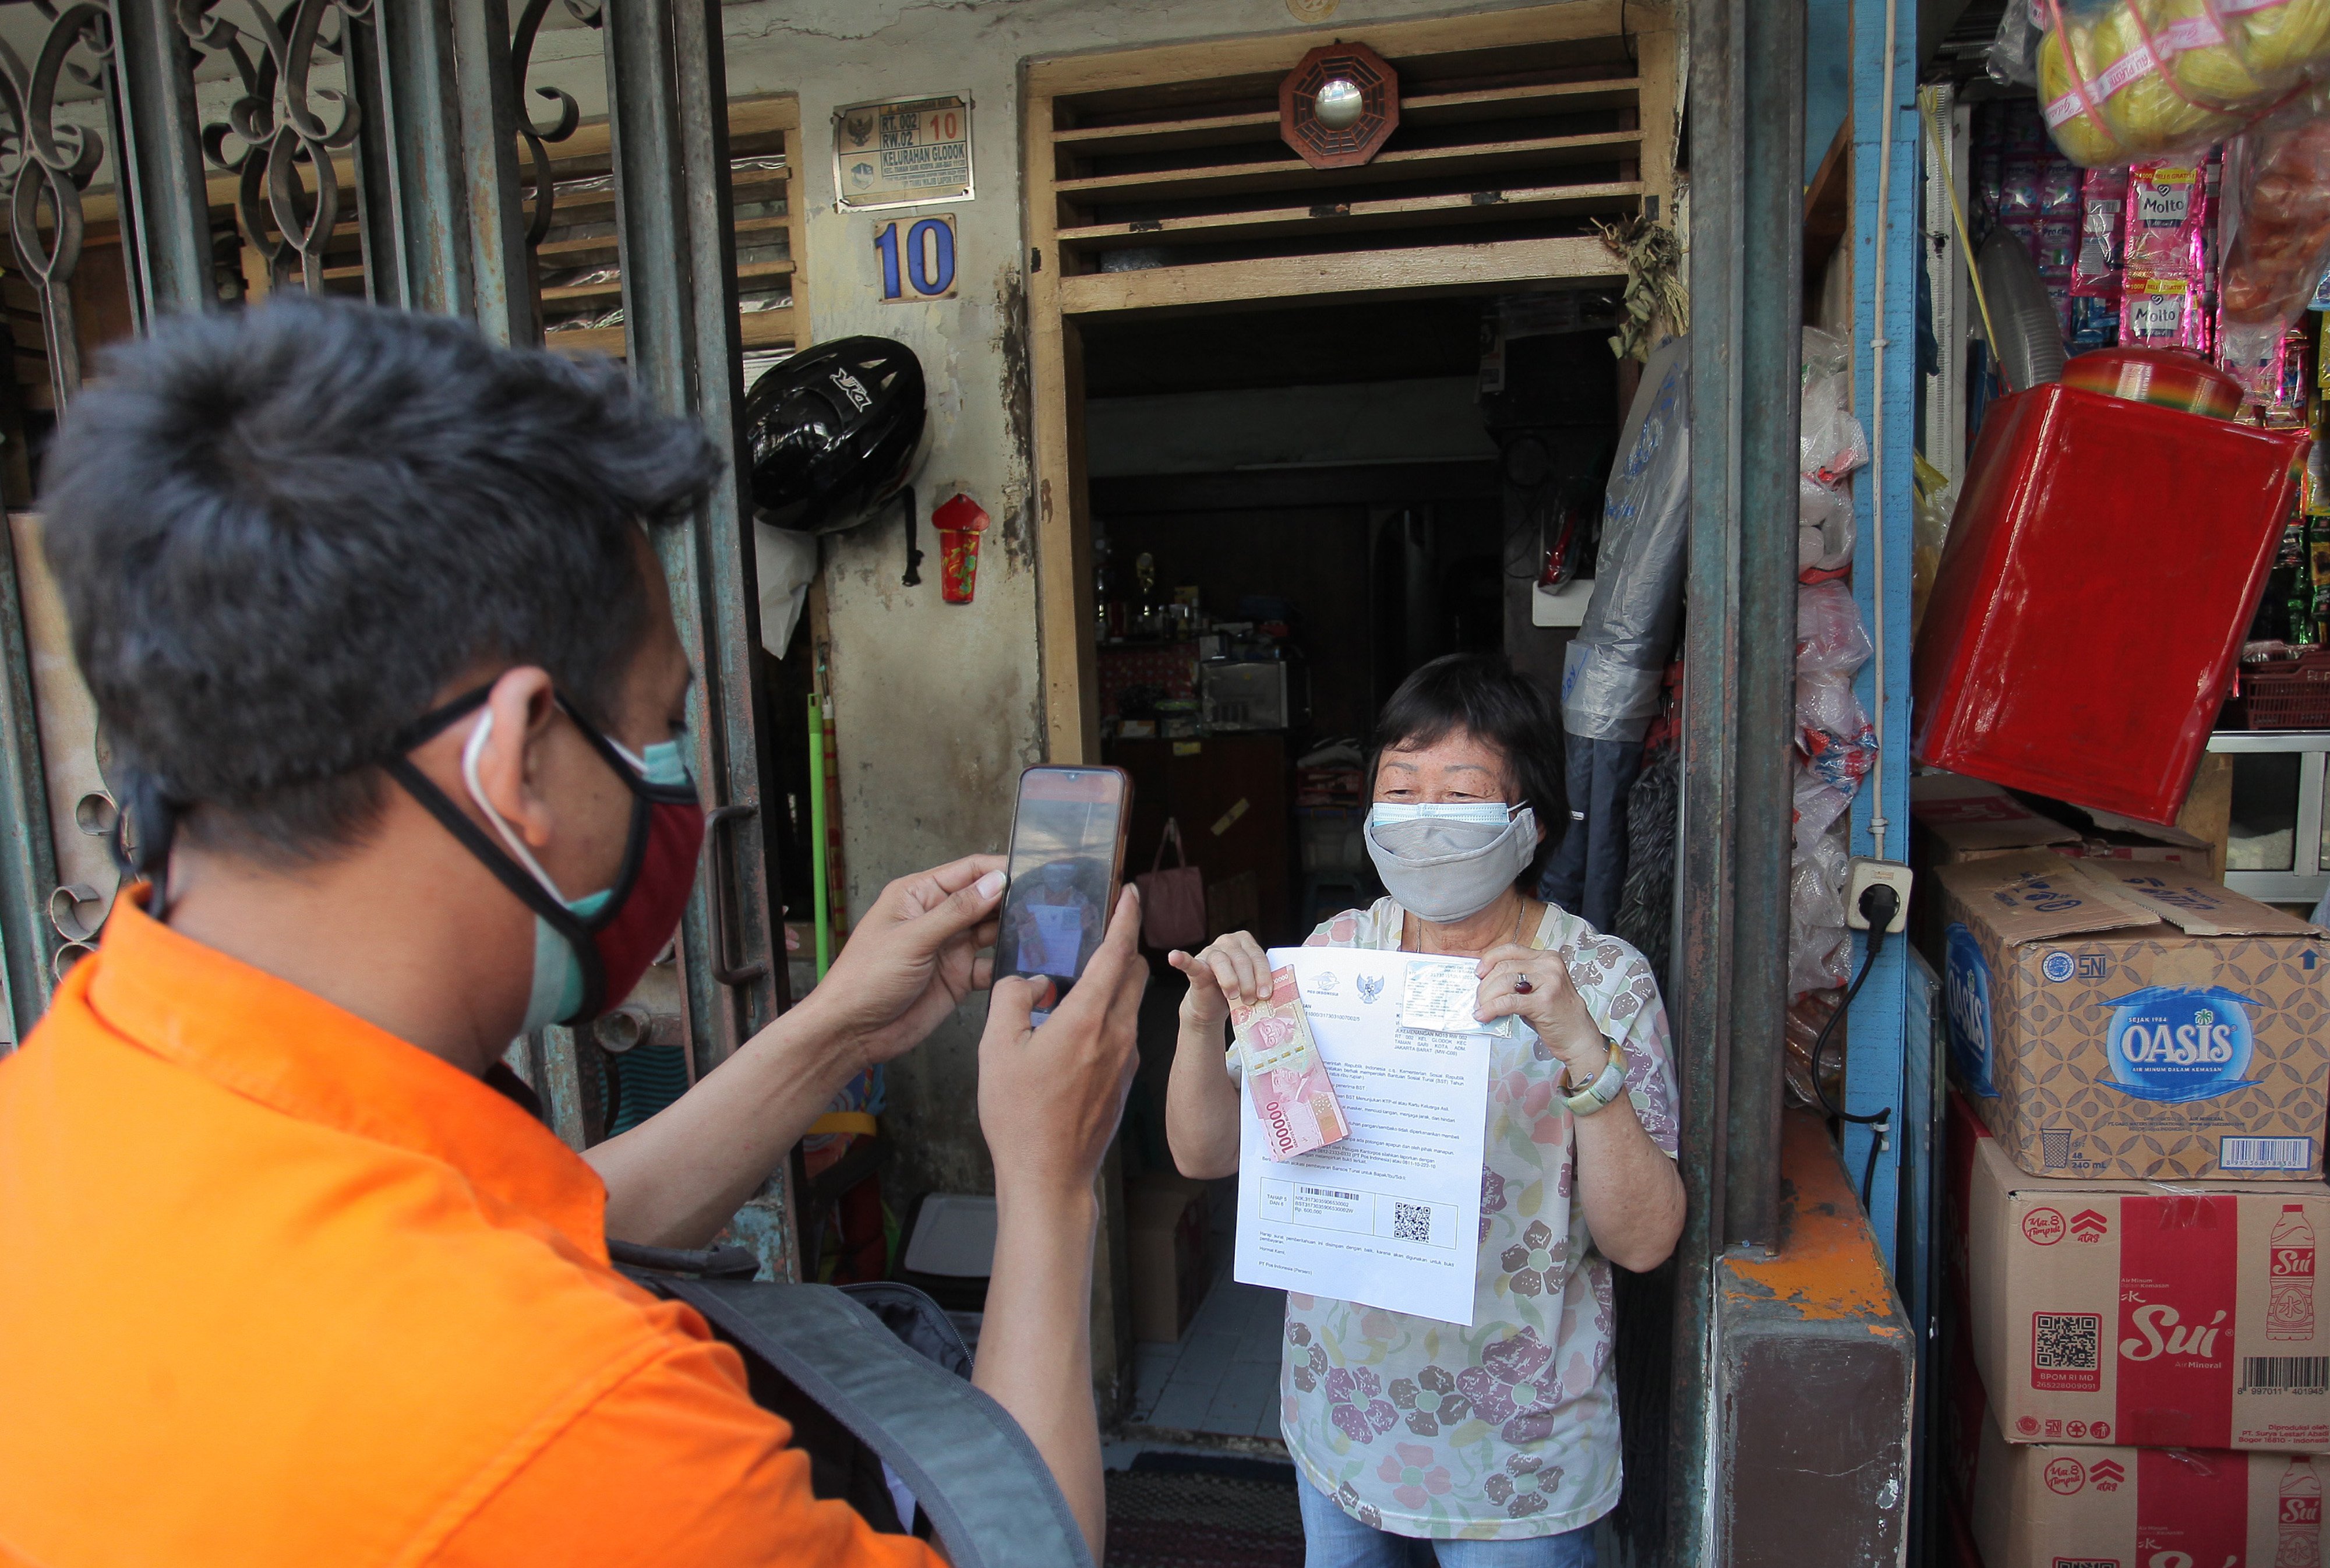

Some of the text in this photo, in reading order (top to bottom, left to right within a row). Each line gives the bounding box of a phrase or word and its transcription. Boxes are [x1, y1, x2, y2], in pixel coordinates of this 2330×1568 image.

[882, 114, 916, 130] RT. 002
[930, 112, 956, 140] 10
[882, 143, 965, 167] KELURAHAN GLODOK
[2144, 197, 2184, 213] Molto
[2042, 225, 2071, 236] Proclin
[874, 218, 955, 299] 10
[2135, 308, 2175, 322] Molto
[2078, 958, 2106, 977] SNI
[2120, 1024, 2234, 1065] OASIS
[1266, 1101, 1294, 1154] 100000
[1410, 1129, 1441, 1138] diperkenankan
[2050, 1216, 2059, 1225] 8
[1259, 1237, 1284, 1245] pembayaran.
[2077, 1232, 2099, 1243] atas
[1286, 1236, 1316, 1245] pemberitahuan
[1325, 1241, 1344, 1249] disimpan
[1406, 1255, 1428, 1263] digunakan
[1274, 1263, 1293, 1272] Indonesia
[1294, 1267, 1313, 1276] (Persero)
[2279, 1295, 2301, 1319] 水
[2096, 1481, 2118, 1492] atas
